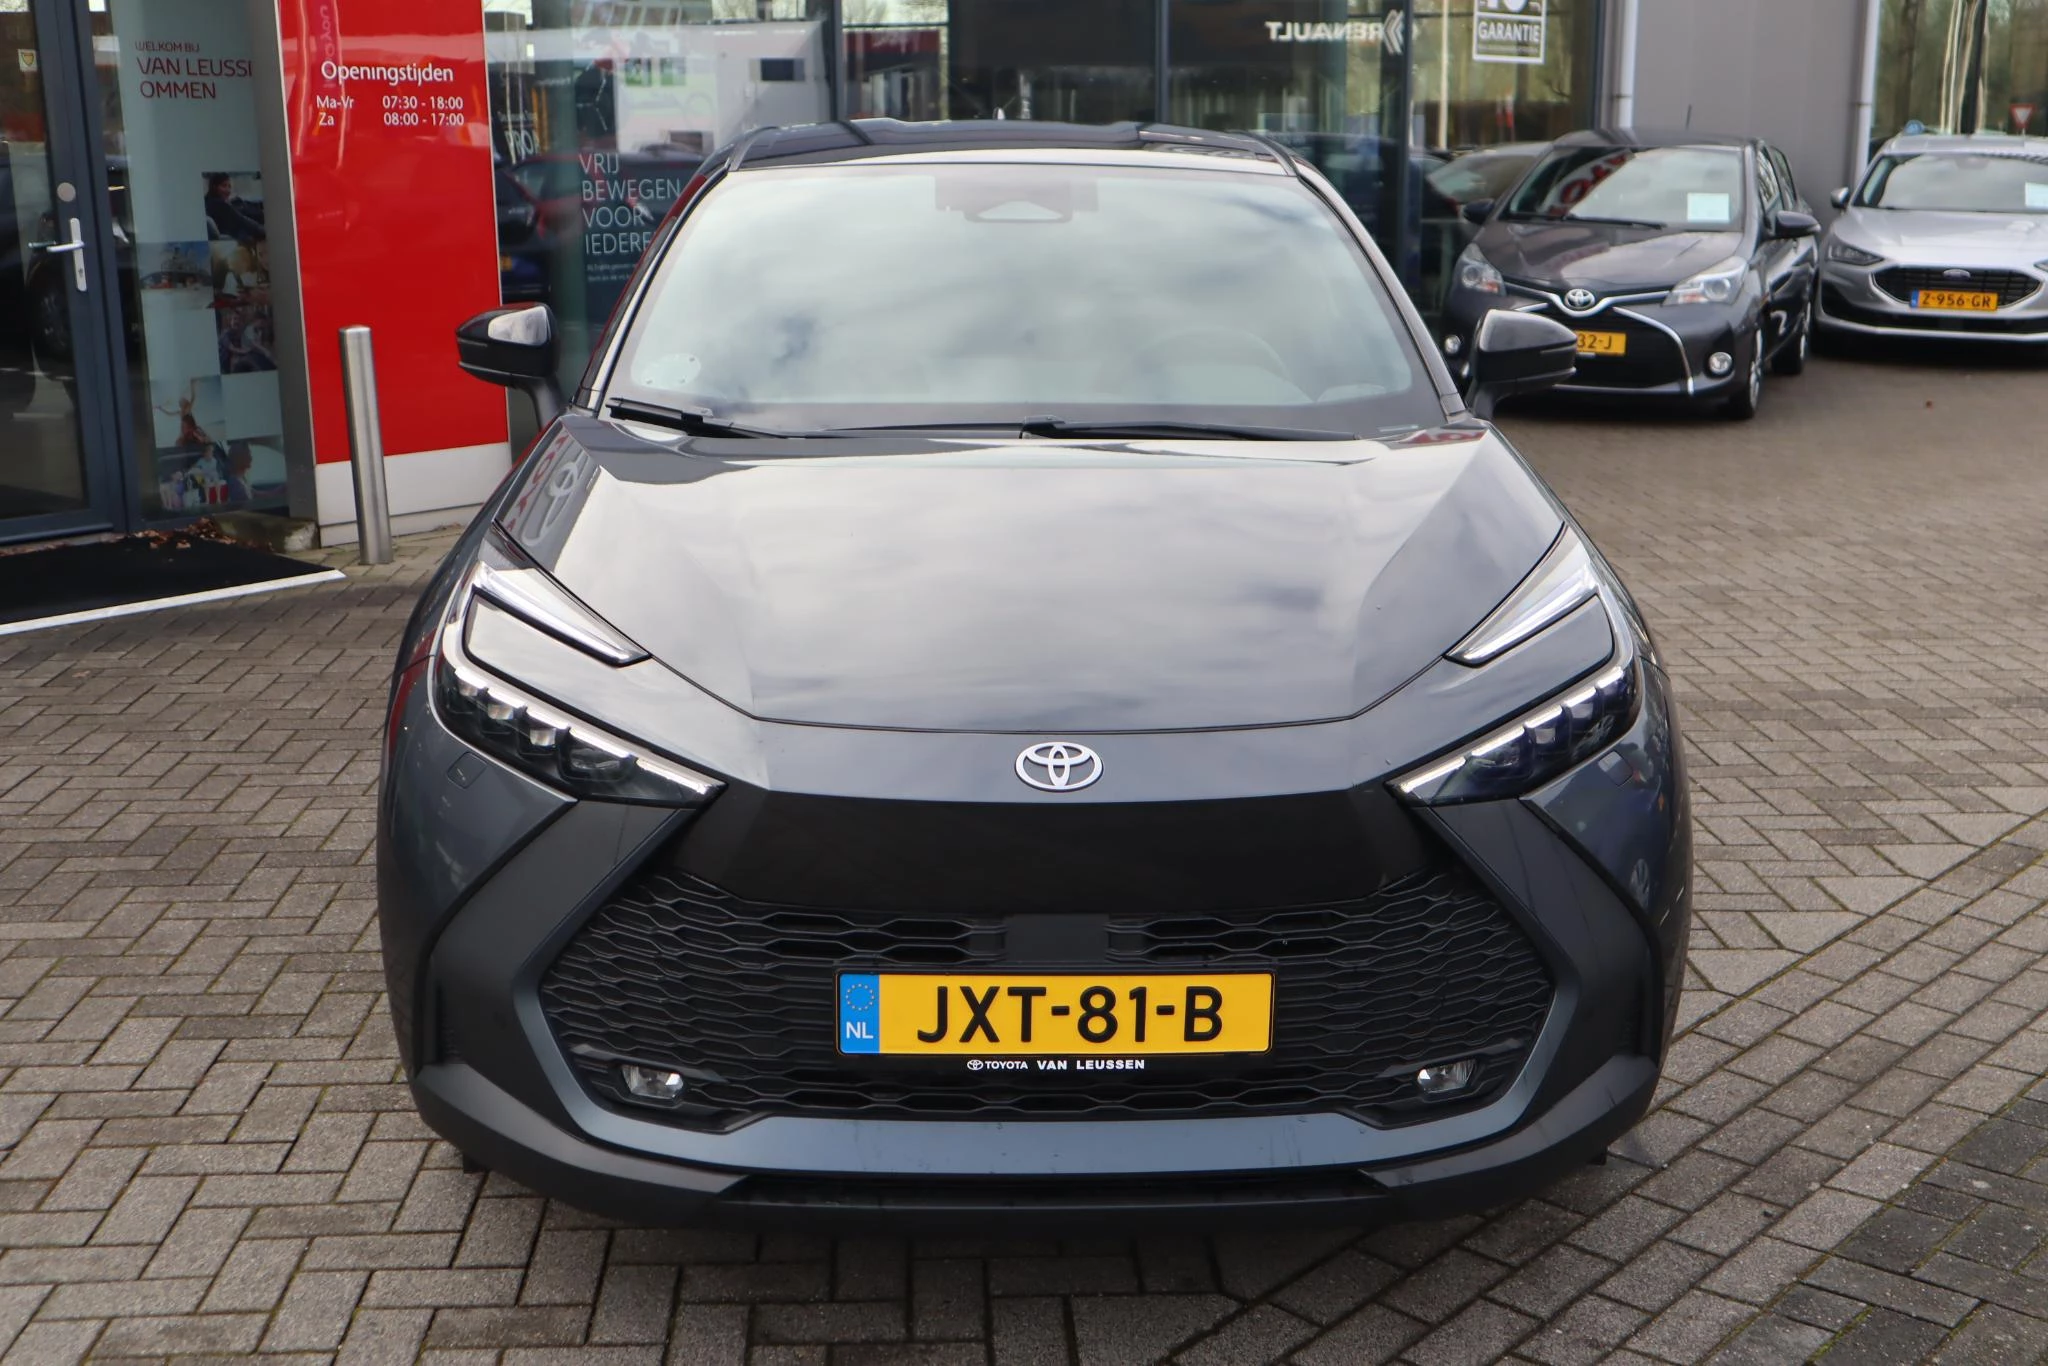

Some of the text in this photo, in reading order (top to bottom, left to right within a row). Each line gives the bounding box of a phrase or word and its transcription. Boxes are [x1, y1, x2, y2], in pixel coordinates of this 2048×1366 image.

[1478, 20, 1540, 42] GARANTIE
[135, 41, 182, 52] WELKOM
[137, 57, 180, 76] VAN
[321, 60, 454, 86] Openingstijden
[140, 80, 217, 99] OMMEN
[316, 95, 355, 110] Ma-Vr
[382, 95, 418, 110] 07:30
[430, 96, 464, 110] 18:00
[318, 112, 335, 126] Za
[383, 112, 419, 126] 08:00
[430, 113, 465, 126] 17:00
[579, 152, 620, 175] VRIJ
[582, 179, 680, 201] BEWEGEN
[582, 206, 646, 228] VOOR
[585, 232, 655, 254] IEDERE
[1922, 291, 1991, 309] Z-956-GR
[845, 985, 1223, 1044] NL JXT-81-B
[985, 1059, 1145, 1070] TOYOTA VAN LEUSSEN
